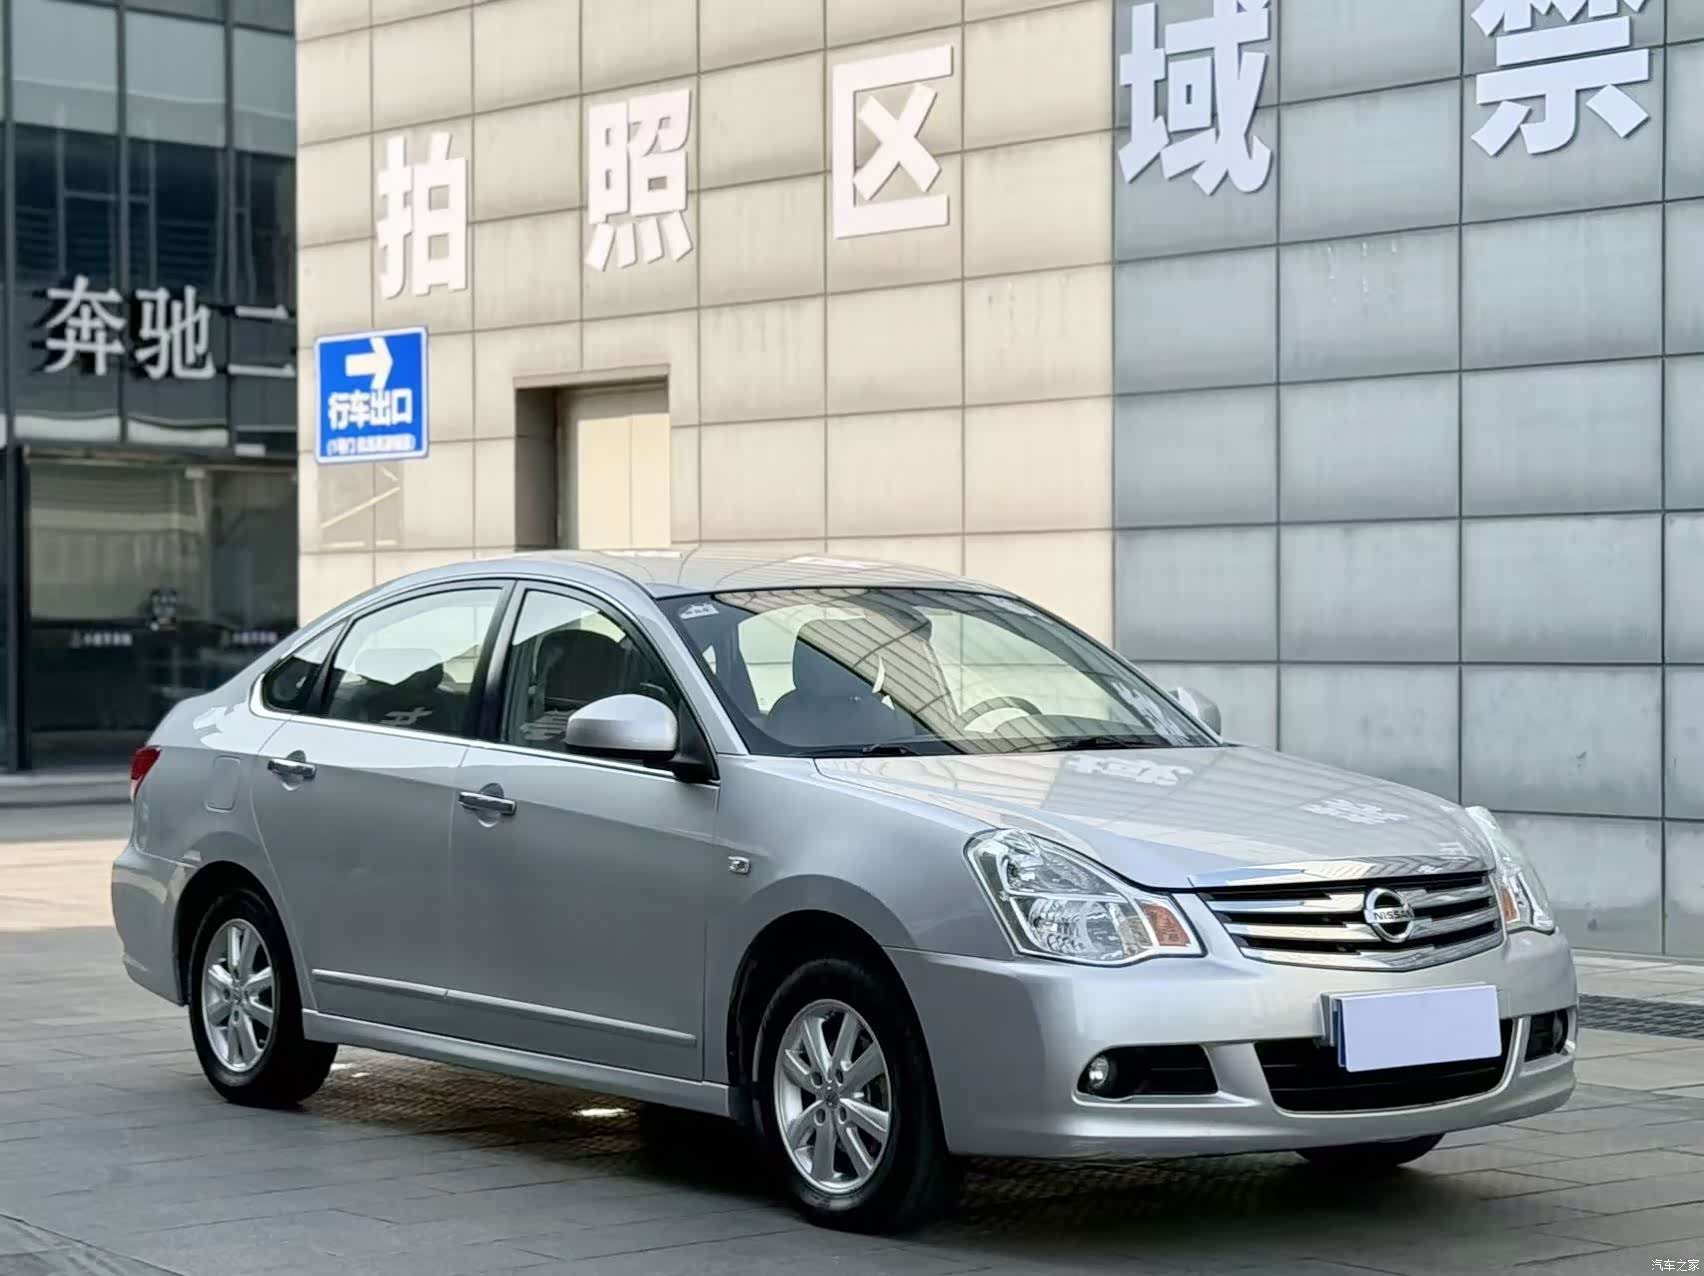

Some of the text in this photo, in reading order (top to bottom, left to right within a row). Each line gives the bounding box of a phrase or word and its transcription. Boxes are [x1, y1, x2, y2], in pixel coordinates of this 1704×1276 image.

[44, 274, 296, 379] 奔驰二
[327, 388, 413, 430] 行车出口
